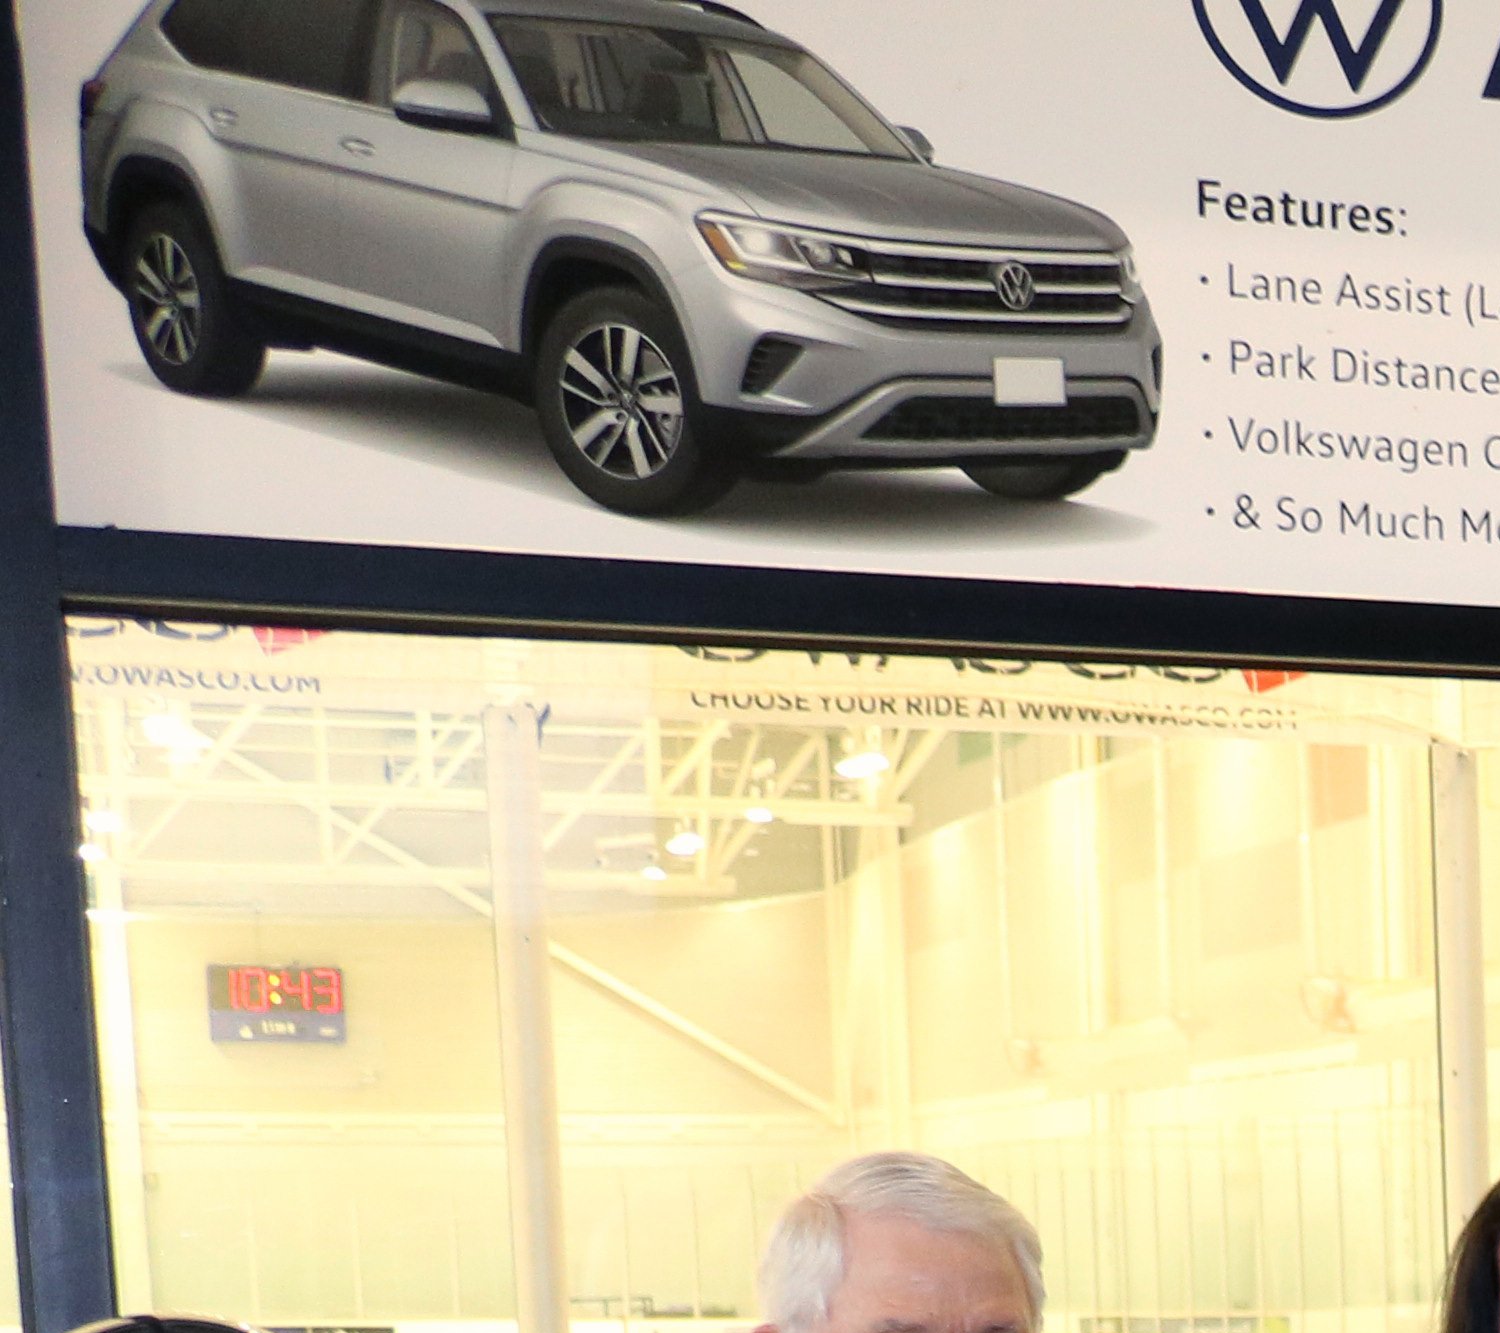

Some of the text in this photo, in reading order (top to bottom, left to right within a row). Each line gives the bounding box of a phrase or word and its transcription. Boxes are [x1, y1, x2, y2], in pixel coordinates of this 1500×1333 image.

[1198, 180, 1405, 235] Features:
[1229, 263, 1321, 304] Lane
[1336, 273, 1450, 315] Assist
[1231, 340, 1315, 380] Park
[1333, 348, 1500, 394] Distance
[1228, 417, 1467, 473] Volkswagen
[1234, 494, 1259, 528] &
[1277, 497, 1322, 533] So
[1340, 501, 1443, 540] Much
[228, 966, 343, 1015] 10:43
